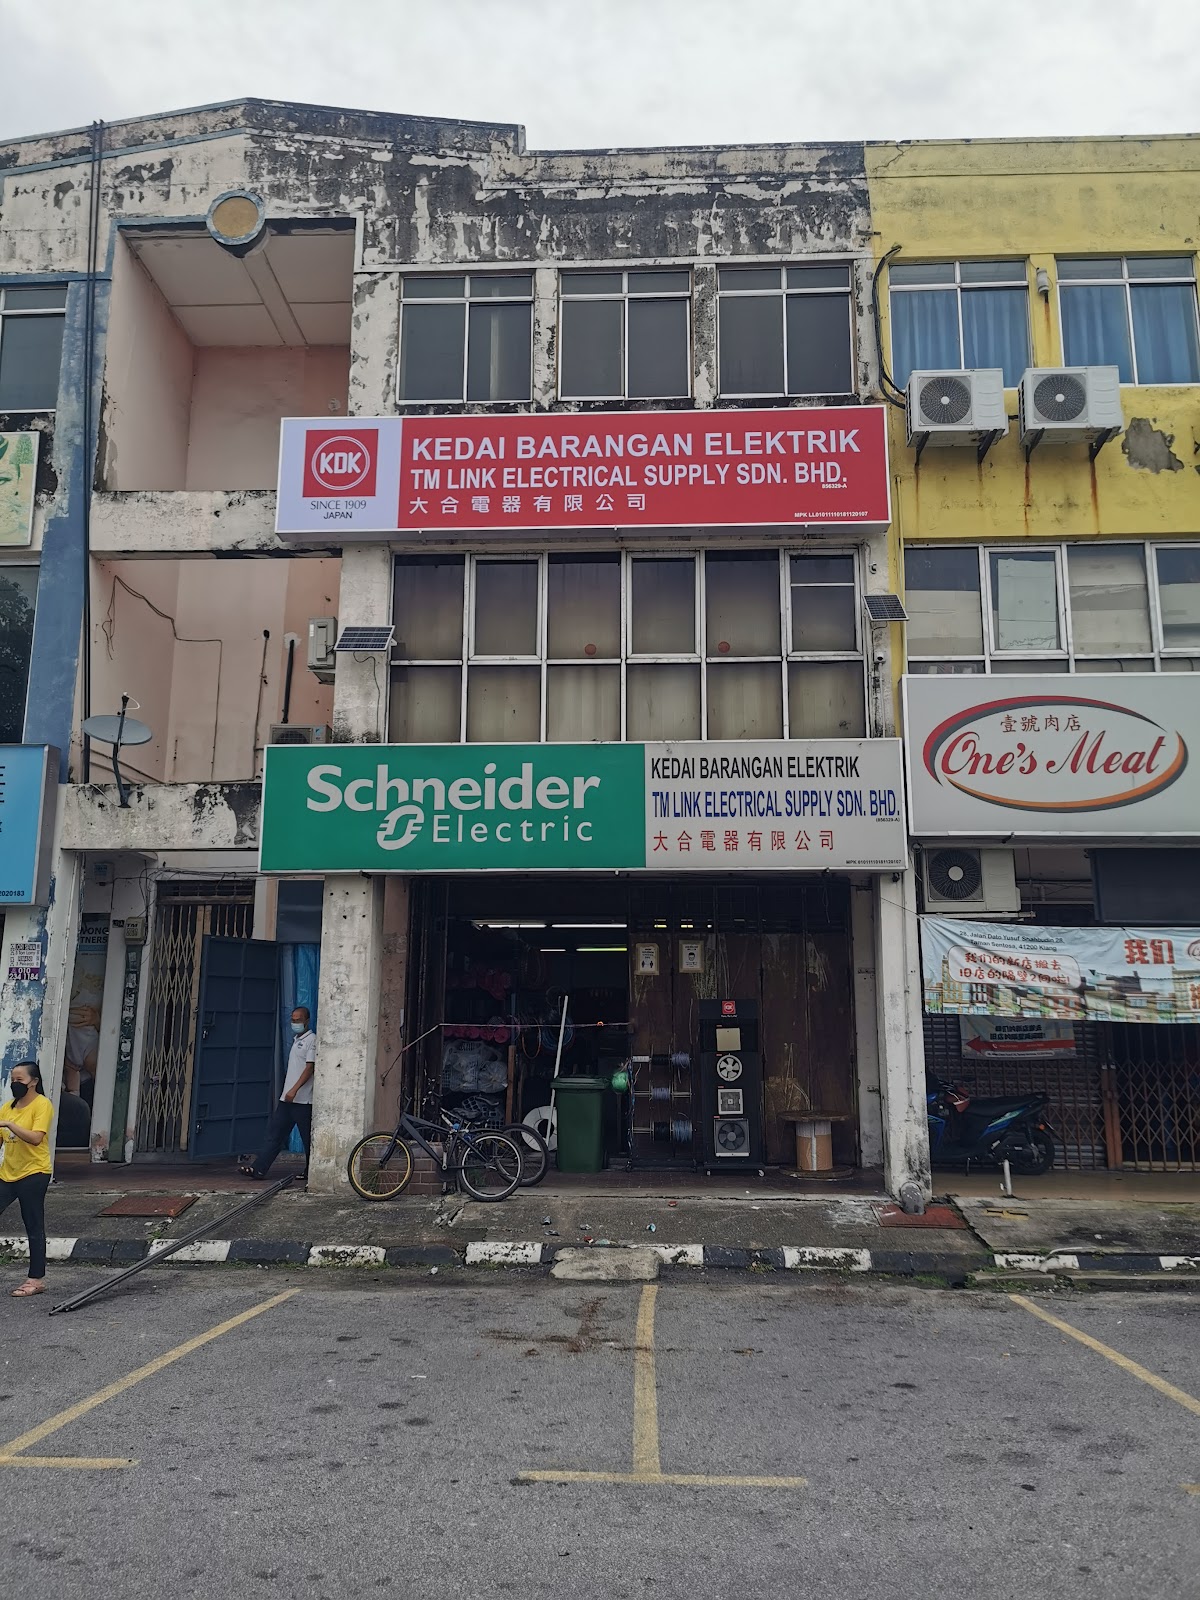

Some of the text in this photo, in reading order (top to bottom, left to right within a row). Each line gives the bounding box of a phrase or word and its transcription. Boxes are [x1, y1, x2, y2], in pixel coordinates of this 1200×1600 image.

[412, 429, 861, 461] KEDAI BARANGAN ELEKTRIK
[320, 452, 362, 474] KDK
[410, 461, 848, 490] TM LINK ELECTRICAL SUPPLY SDN. BHD.
[310, 499, 367, 511] SINCE 1909
[409, 492, 646, 515] 大合電器有限公司
[323, 511, 353, 520] JAPAN
[1000, 714, 1082, 733] 壹號肉店
[941, 730, 1166, 775] One's Meat
[651, 756, 860, 779] KEDAI BARANGAN ELEKTRIK
[306, 762, 601, 812] Schneider
[652, 789, 900, 818] TM LINK ELECTRICAL SUPPLY SDN. BHD.
[432, 815, 593, 843] Electric
[653, 829, 834, 852] 大合電器有限公司
[970, 932, 987, 940] Jalan
[1124, 938, 1176, 965] 我们
